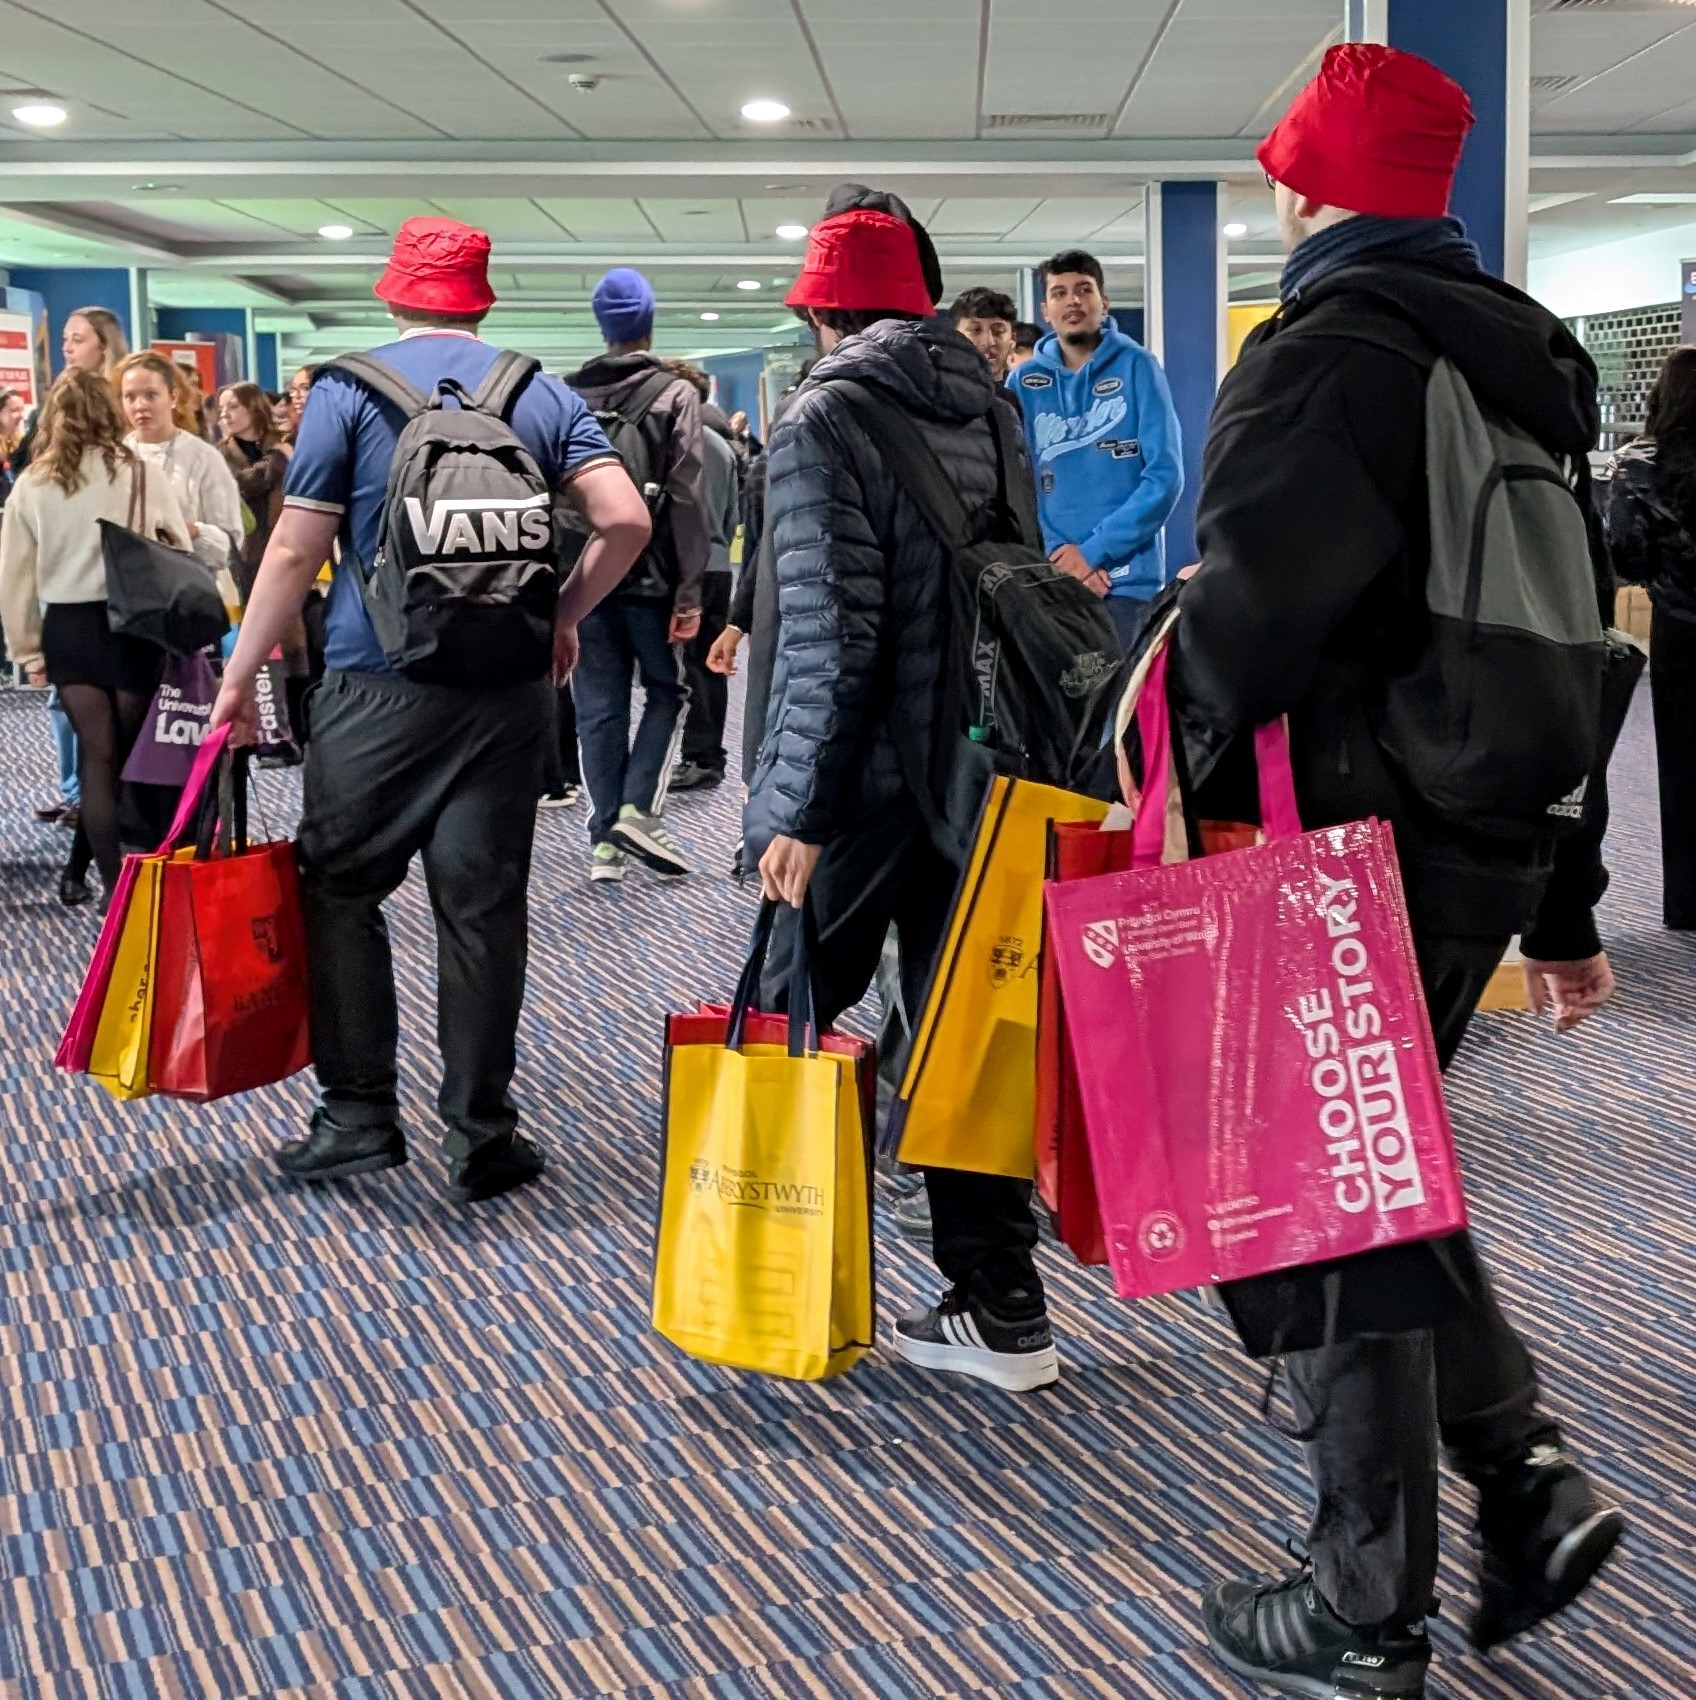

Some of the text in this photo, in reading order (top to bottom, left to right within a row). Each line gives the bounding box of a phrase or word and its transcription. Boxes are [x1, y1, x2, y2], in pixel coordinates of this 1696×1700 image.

[403, 492, 551, 555] VANS
[159, 684, 182, 699] The
[1301, 988, 1371, 1214] CHOOSE
[1318, 873, 1416, 1211] YOUR STORY
